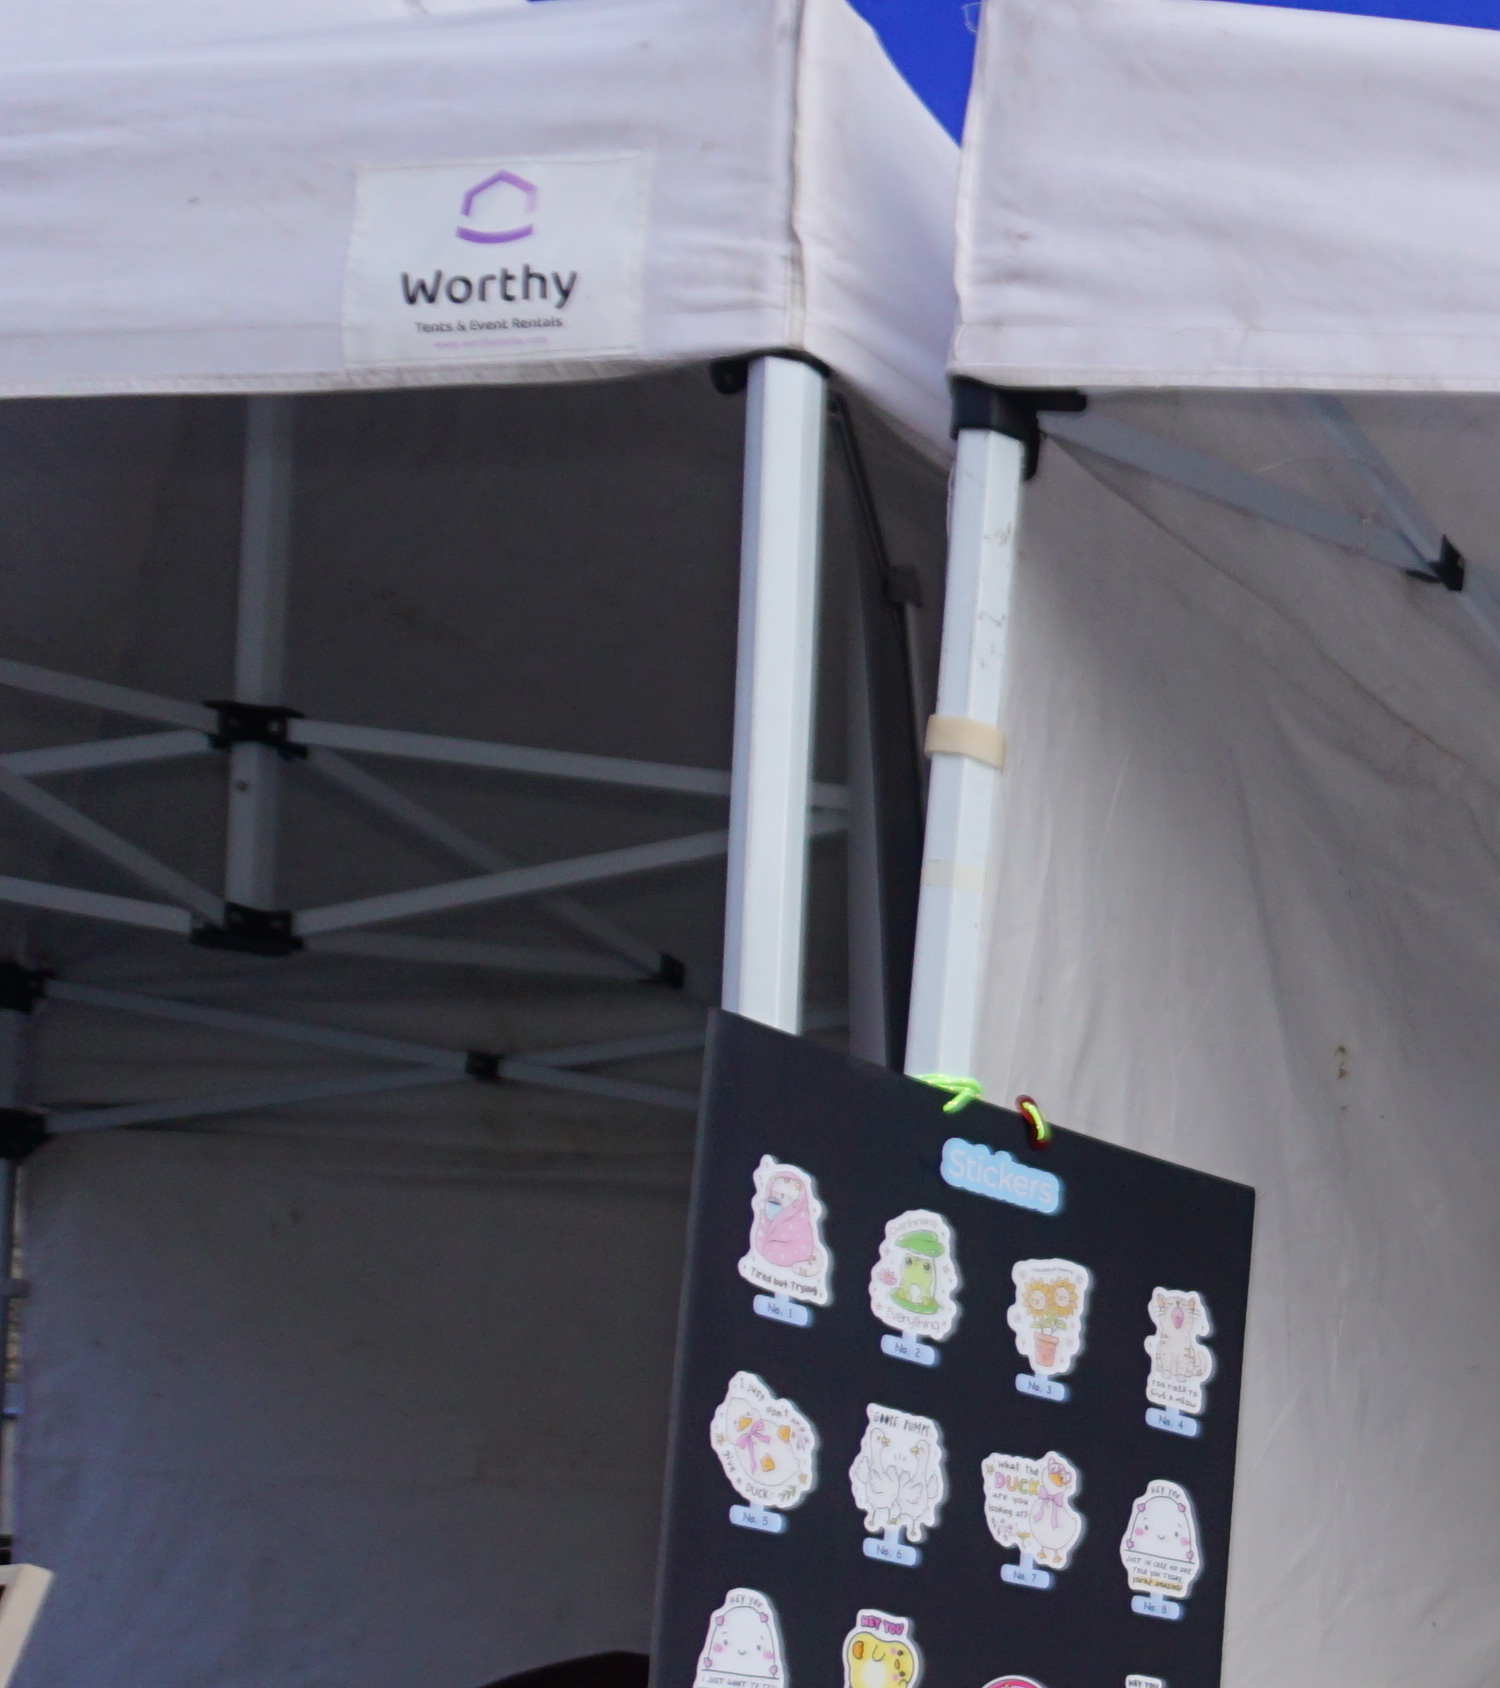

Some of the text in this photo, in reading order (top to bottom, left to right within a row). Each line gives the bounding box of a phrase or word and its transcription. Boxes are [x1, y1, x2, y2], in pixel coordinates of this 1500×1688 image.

[401, 263, 578, 309] Worthy
[415, 315, 563, 334] Tents & Event Rentals
[948, 1149, 1053, 1205] Stickers
[994, 1471, 1041, 1496] DUCK
[992, 1492, 1028, 1505] are you
[860, 1615, 904, 1635] HEY YOU
[1128, 1679, 1143, 1688] HEY
